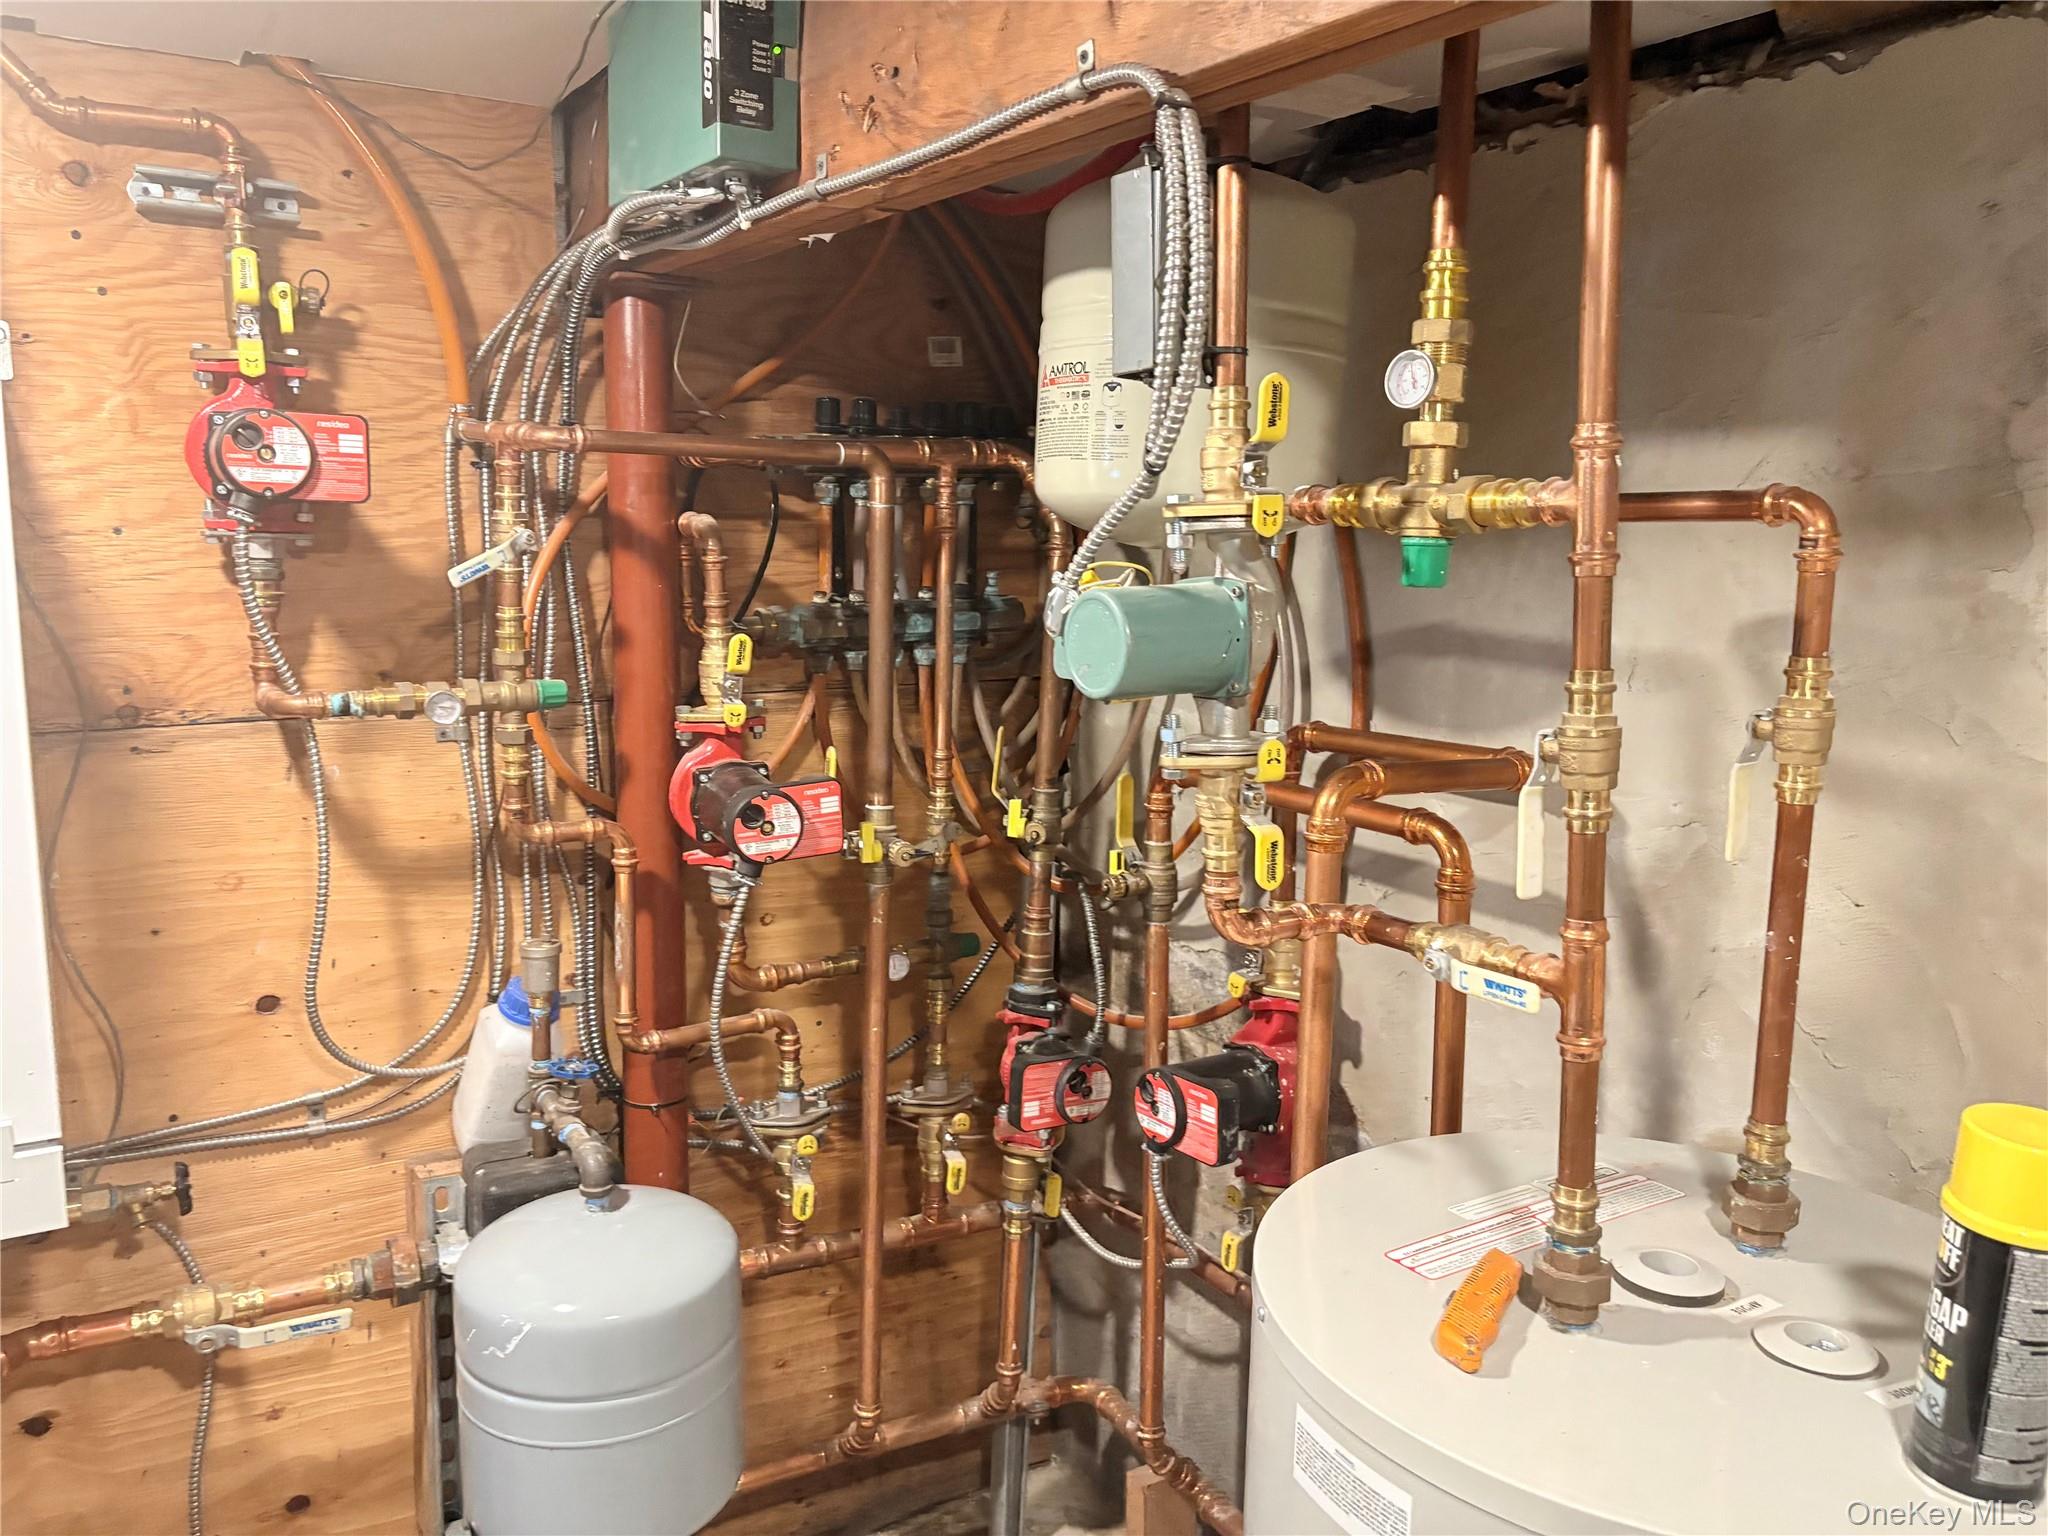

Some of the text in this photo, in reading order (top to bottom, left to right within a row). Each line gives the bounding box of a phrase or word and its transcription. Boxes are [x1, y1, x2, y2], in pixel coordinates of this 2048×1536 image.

[751, 48, 767, 57] Zone
[751, 56, 767, 65] Zone
[751, 65, 767, 73] Zone
[734, 88, 760, 100] 3 Zone
[728, 95, 765, 111] Switching
[736, 105, 757, 117] Relay
[1048, 361, 1091, 377] AMTROL
[1268, 382, 1279, 428] Webstone
[1270, 840, 1279, 881] Webstone
[1483, 978, 1526, 998] WATTS
[1929, 1286, 1969, 1335] GAP
